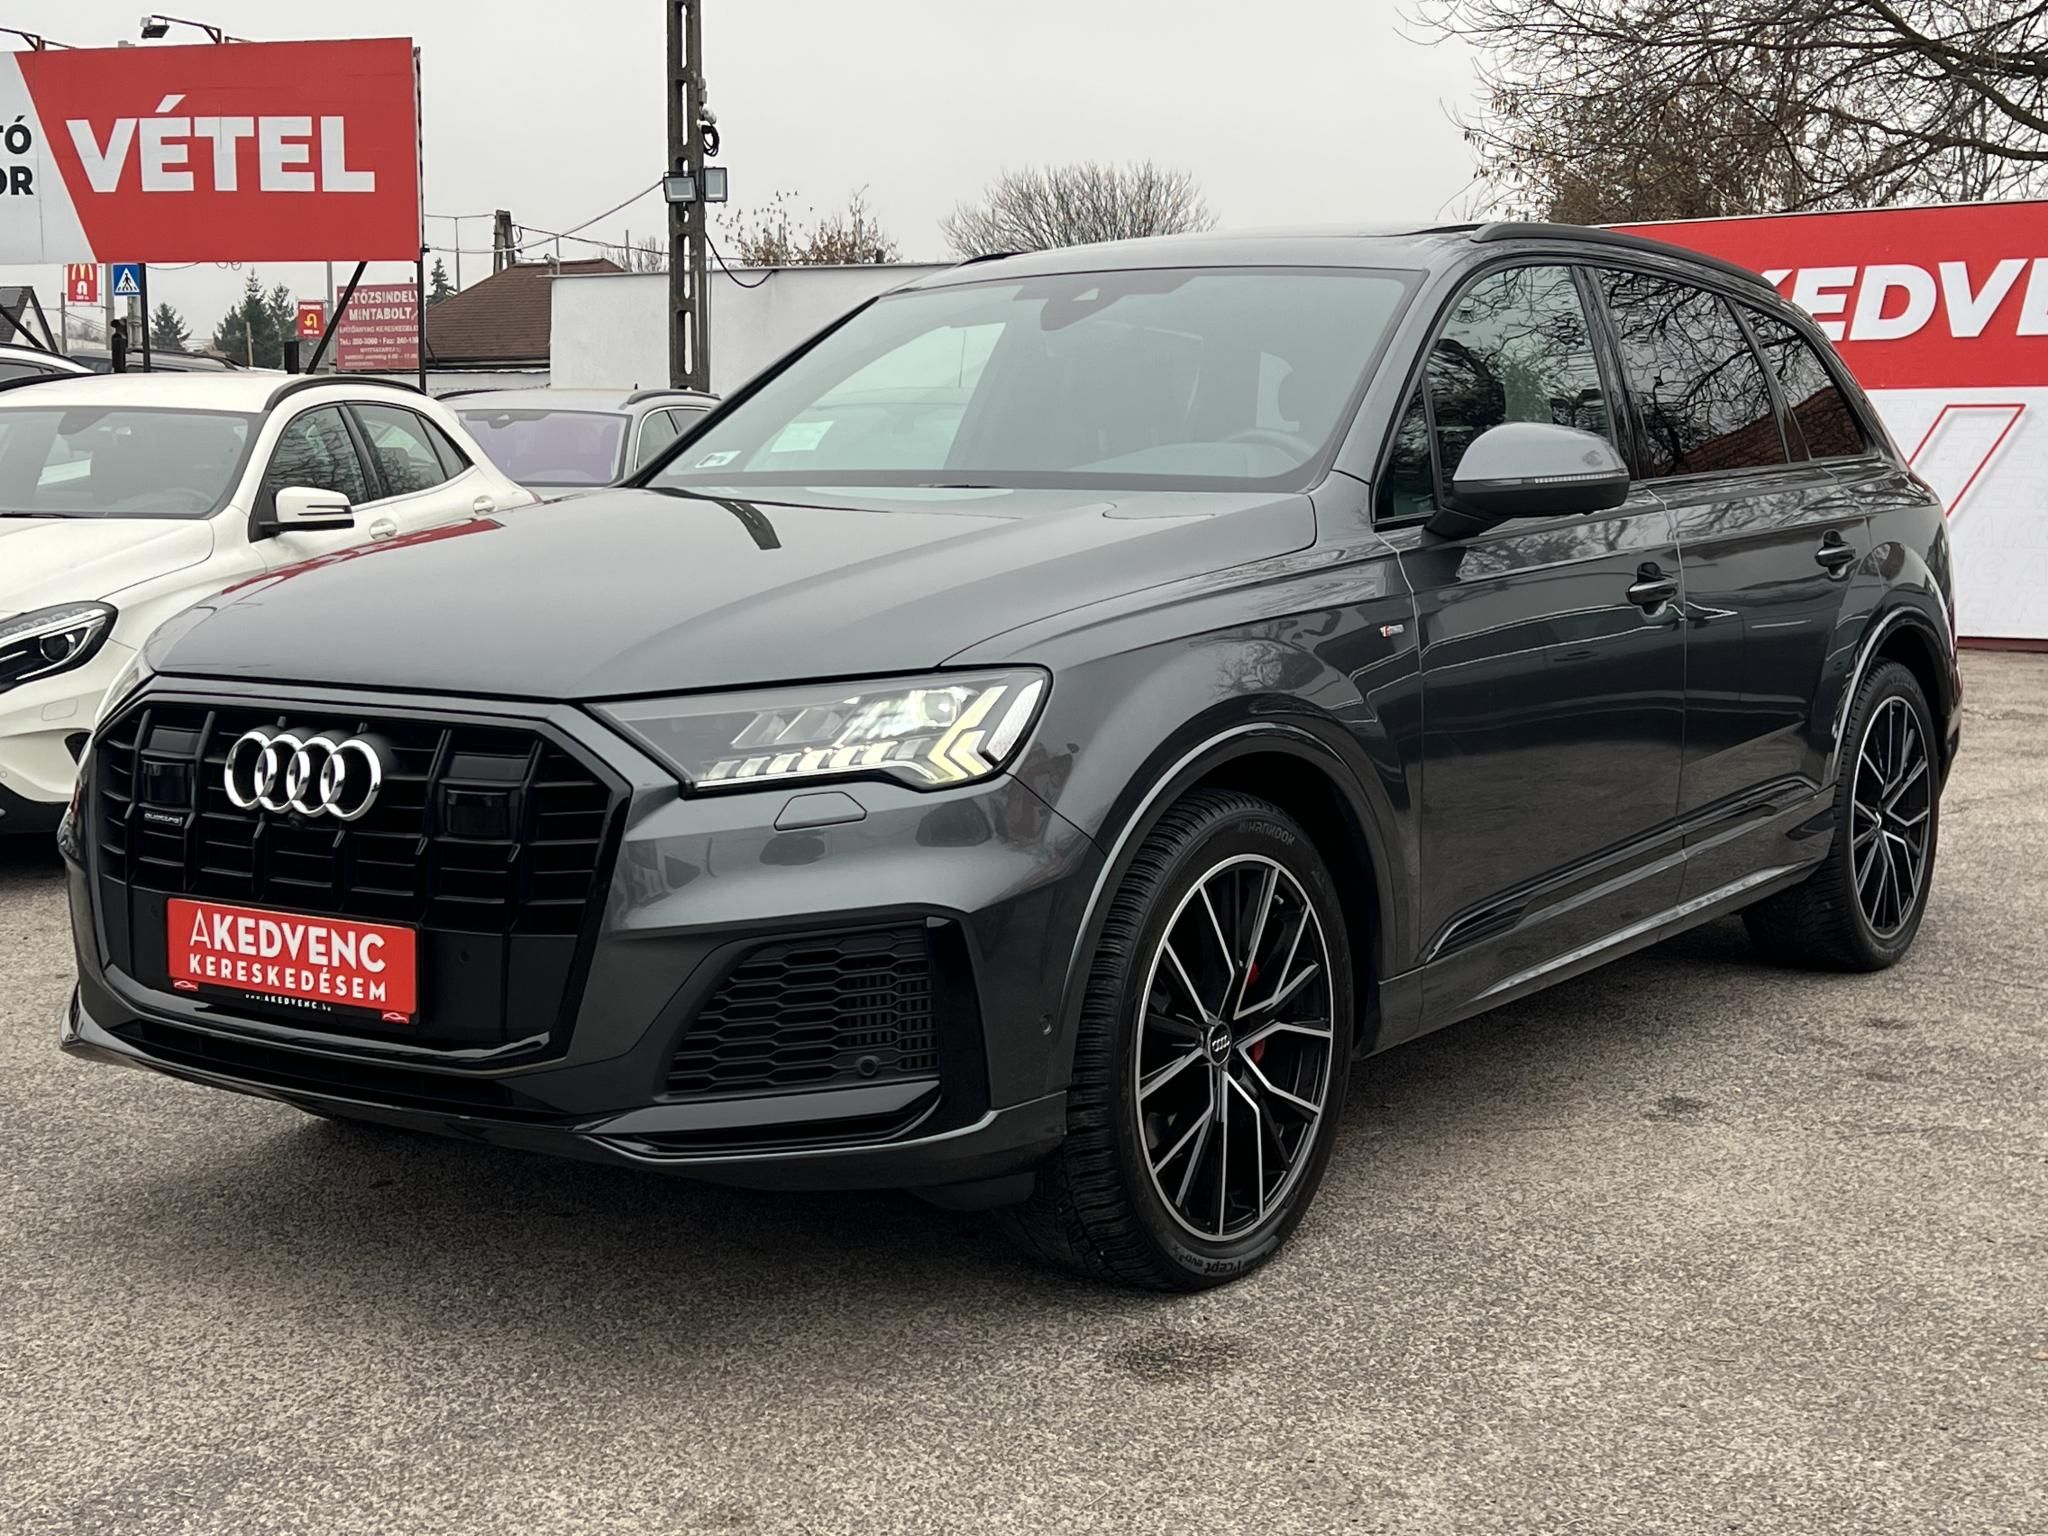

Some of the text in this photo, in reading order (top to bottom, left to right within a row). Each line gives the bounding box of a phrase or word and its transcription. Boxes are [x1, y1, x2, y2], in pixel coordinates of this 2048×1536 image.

[0, 115, 33, 155] Ó
[65, 94, 376, 193] VÉTEL
[0, 166, 34, 196] R
[349, 307, 412, 321] MINTABOLT
[189, 907, 387, 974] AKEDVENC
[189, 952, 387, 1003] KERESKEDÉSEM
